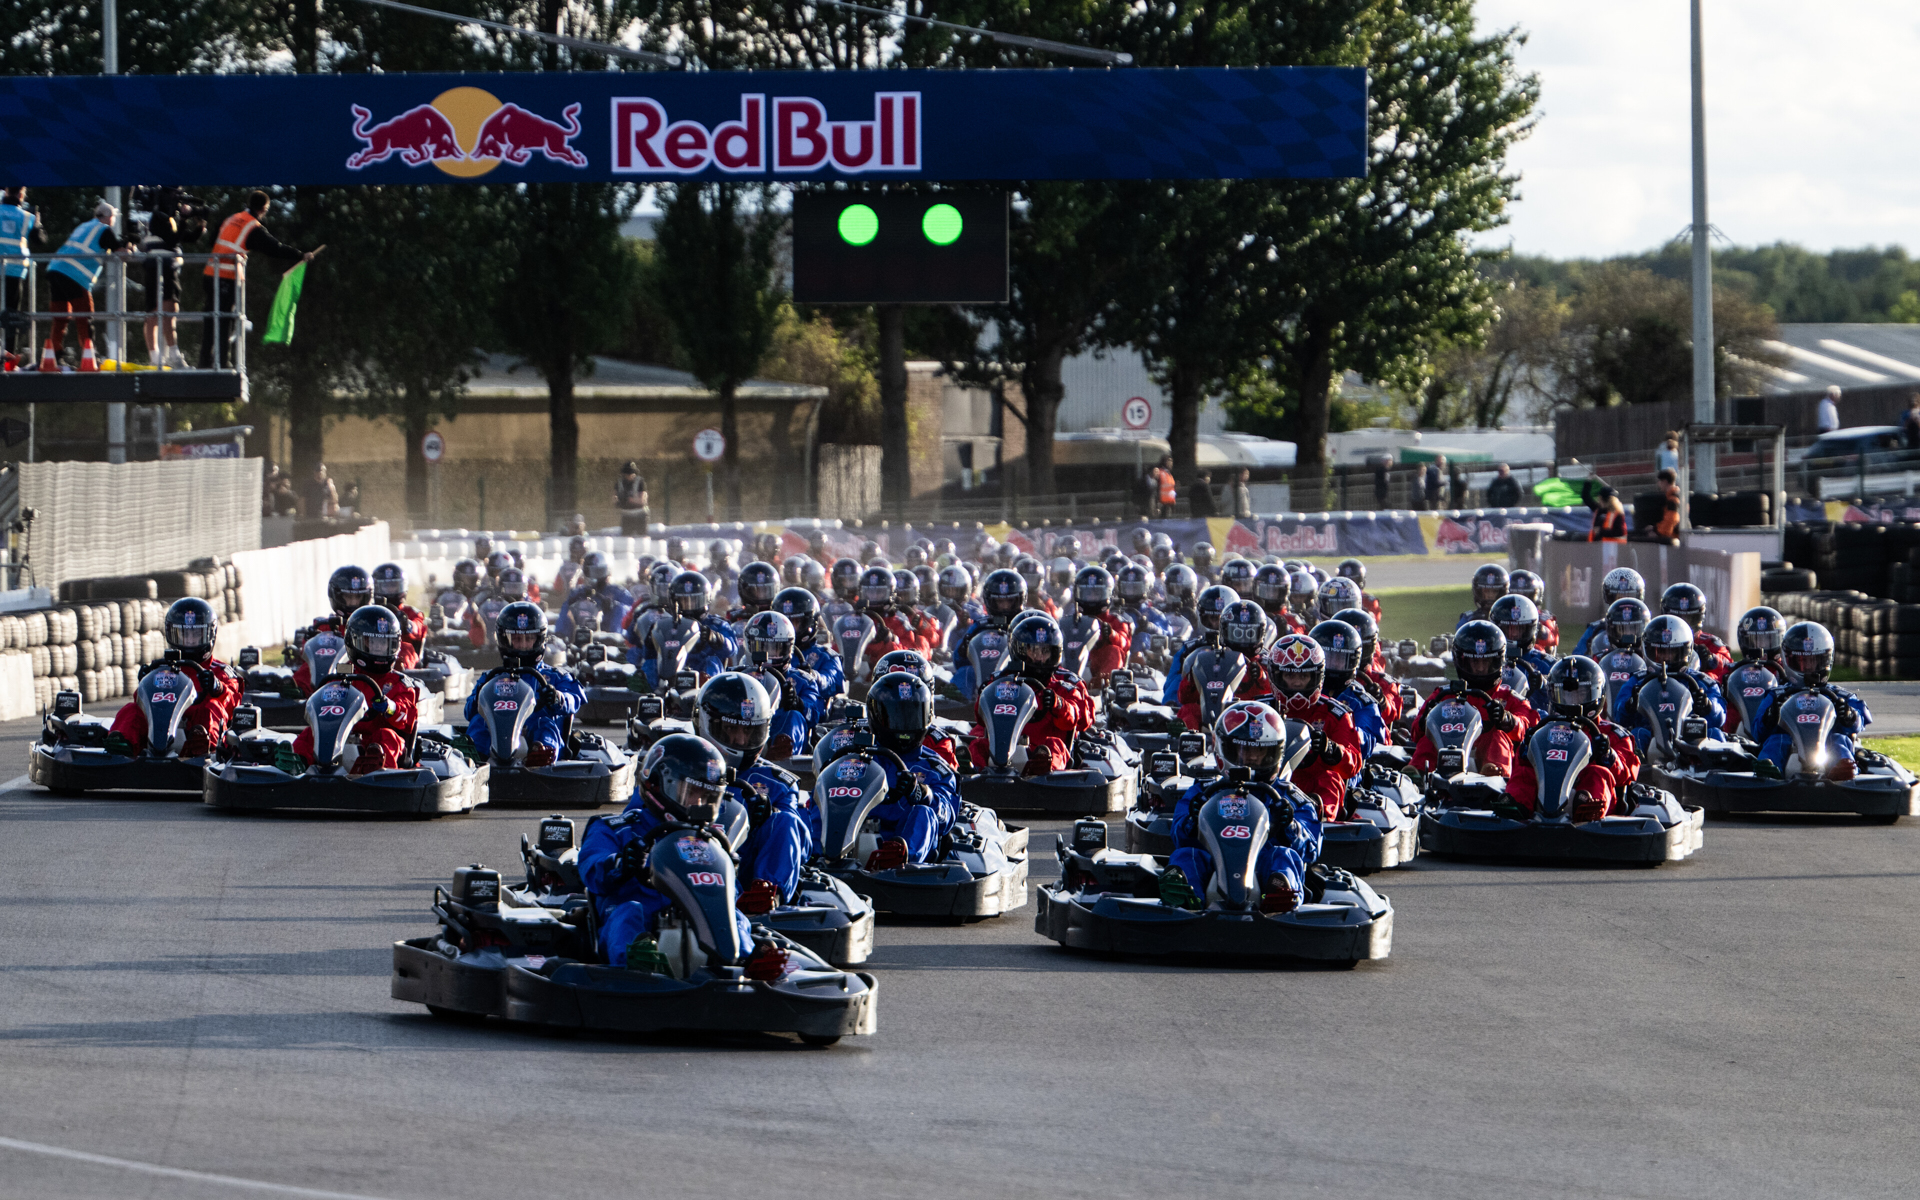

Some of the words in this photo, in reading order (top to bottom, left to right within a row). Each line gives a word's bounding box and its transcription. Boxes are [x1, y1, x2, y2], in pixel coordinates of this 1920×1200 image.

[611, 93, 765, 173] Red
[774, 91, 921, 173] Bull
[1128, 405, 1146, 420] 15
[191, 443, 229, 456] KART
[1267, 525, 1302, 552] Red
[1303, 523, 1338, 551] Bull
[841, 629, 862, 638] 43
[315, 648, 337, 656] 49
[980, 649, 1001, 658] 99
[1609, 672, 1630, 681] 50
[1206, 680, 1225, 689] 32
[151, 692, 177, 703] 54
[1743, 687, 1766, 697] 29
[318, 705, 345, 717] 70
[493, 700, 518, 711] 28
[993, 704, 1018, 715] 52
[1658, 703, 1676, 712] 71
[721, 716, 738, 725] GIVES
[1796, 714, 1821, 724] 82
[1440, 723, 1467, 733] 84
[1232, 738, 1247, 746] GIVES
[1545, 749, 1569, 761] 21
[684, 777, 703, 788] GIVES
[703, 783, 716, 791] YOU
[828, 786, 863, 798] 100
[1220, 825, 1251, 839] 65
[687, 872, 726, 886] 101
